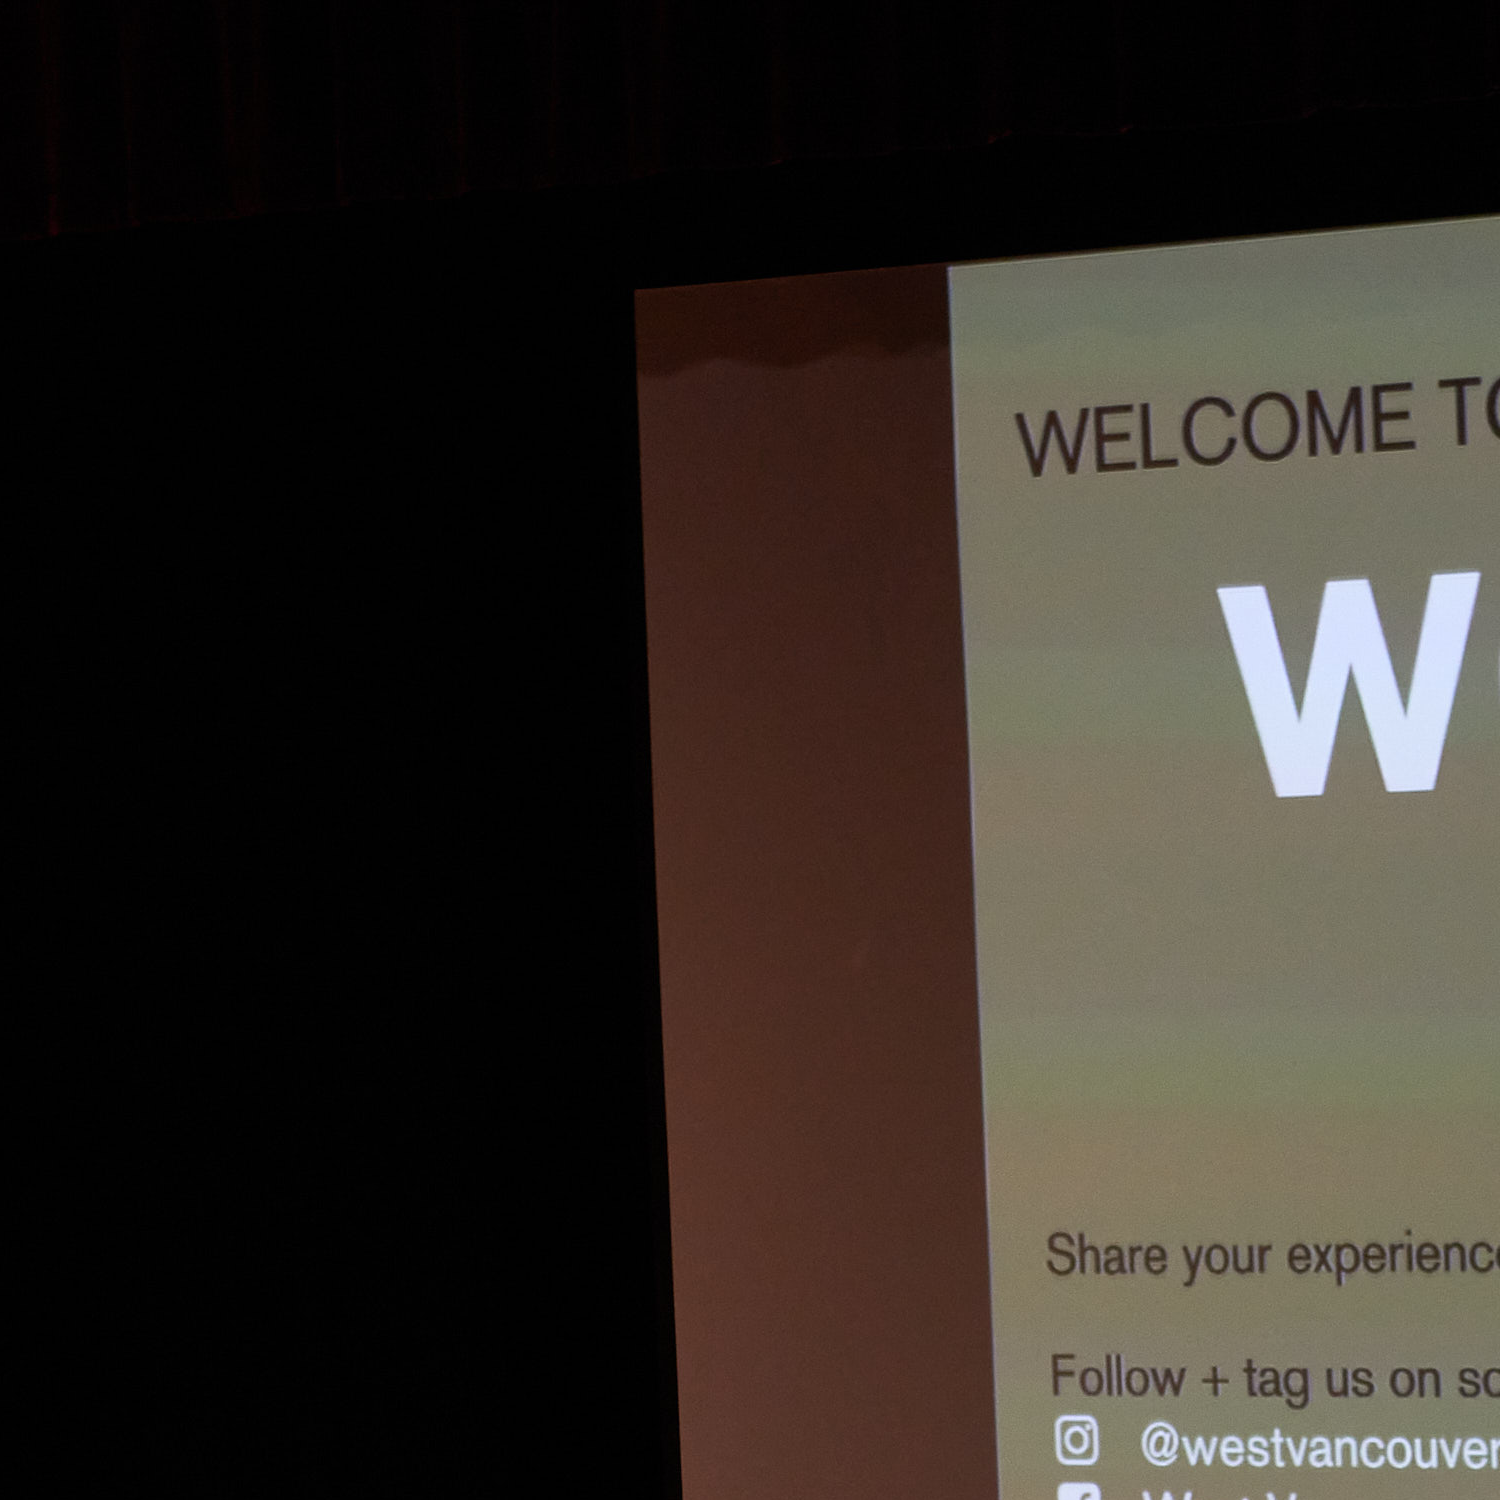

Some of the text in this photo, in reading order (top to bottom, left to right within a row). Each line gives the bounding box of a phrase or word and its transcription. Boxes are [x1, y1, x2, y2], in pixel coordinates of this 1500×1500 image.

[1015, 381, 1416, 478] WELCOME
[1045, 1232, 1168, 1278] Share
[1182, 1237, 1272, 1287] your
[1050, 1354, 1187, 1398] Follow
[1202, 1367, 1230, 1396] +
[1243, 1358, 1310, 1410] tag
[1325, 1363, 1375, 1399] us
[1390, 1364, 1442, 1399] on
